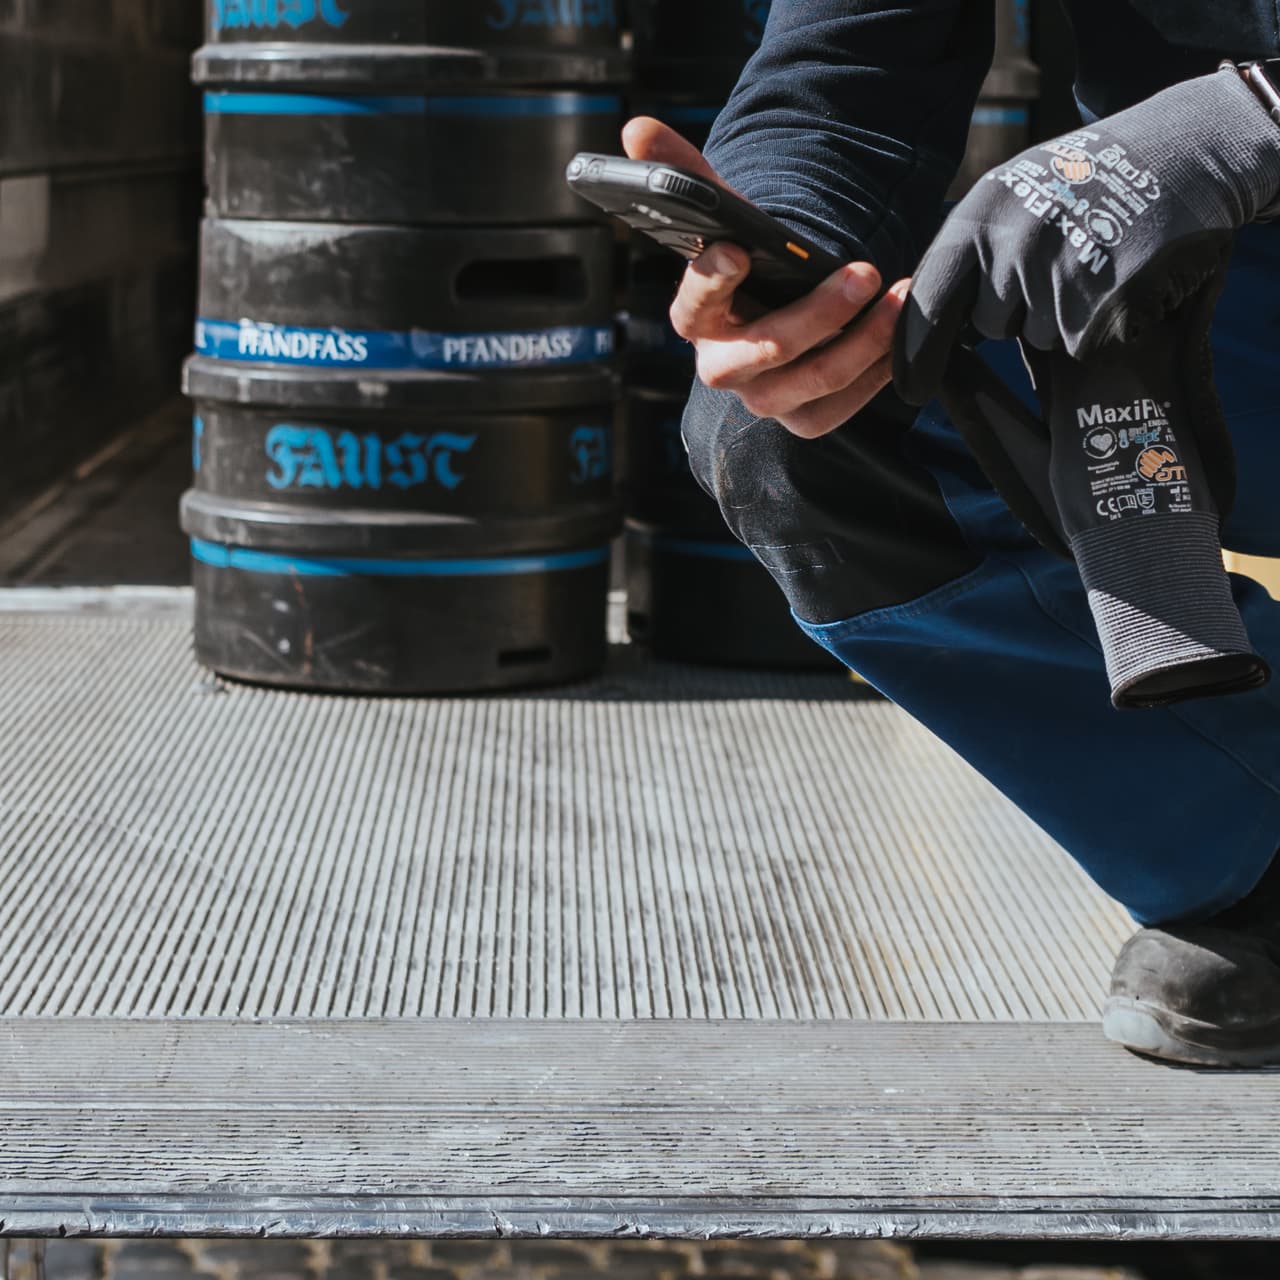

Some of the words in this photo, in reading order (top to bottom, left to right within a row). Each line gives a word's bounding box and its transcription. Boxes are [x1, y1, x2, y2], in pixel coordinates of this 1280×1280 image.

[998, 171, 1110, 275] MaxiFlex
[238, 324, 368, 362] PFANDFASS
[443, 332, 573, 363] PFANDFASS
[265, 423, 478, 490] FAUST
